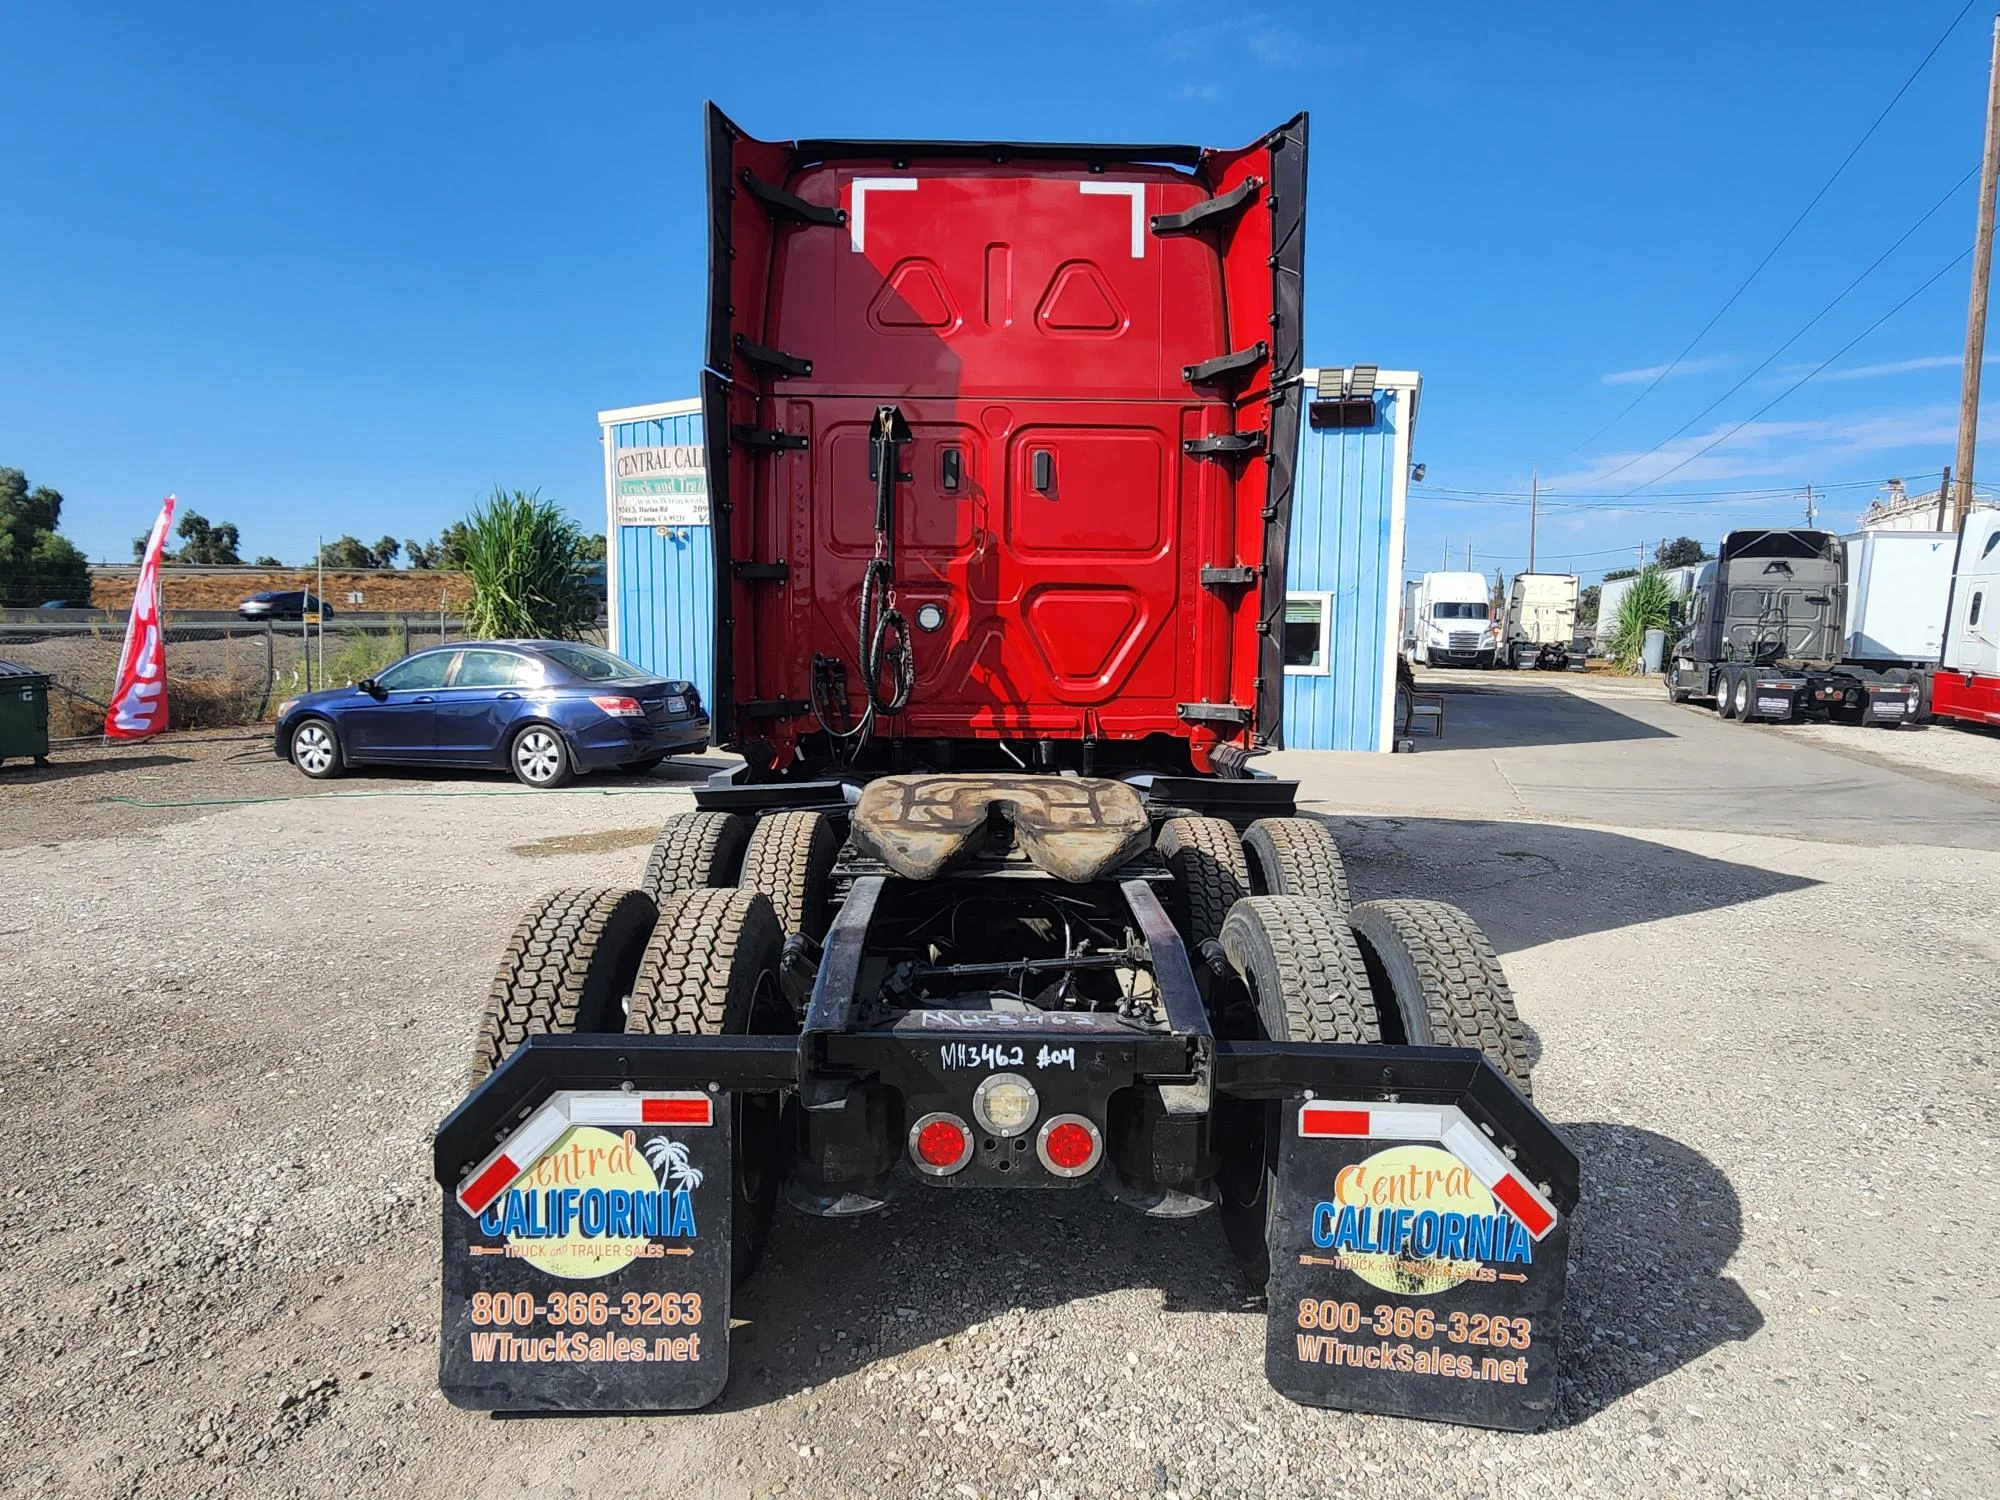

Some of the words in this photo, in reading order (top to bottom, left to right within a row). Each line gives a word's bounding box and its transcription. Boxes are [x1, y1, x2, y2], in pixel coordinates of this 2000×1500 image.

[617, 450, 671, 478] CENTRAL
[655, 478, 676, 493] and
[941, 1043, 1024, 1070] MH3462
[1036, 1044, 1075, 1070] #04
[1312, 1202, 1532, 1264] CALIFORNIA
[503, 1244, 546, 1259] TRUCK
[550, 1244, 568, 1257] and
[571, 1244, 621, 1257] TRAILER
[624, 1243, 665, 1259] SALES
[1333, 1256, 1376, 1272] TRUCK
[1454, 1266, 1497, 1283] SALES
[471, 1291, 702, 1326] 800-366-3263
[1297, 1298, 1532, 1350] 800-366-3263
[470, 1332, 700, 1362] WTruckSales.net
[1296, 1334, 1529, 1385] WTruckSales.net
